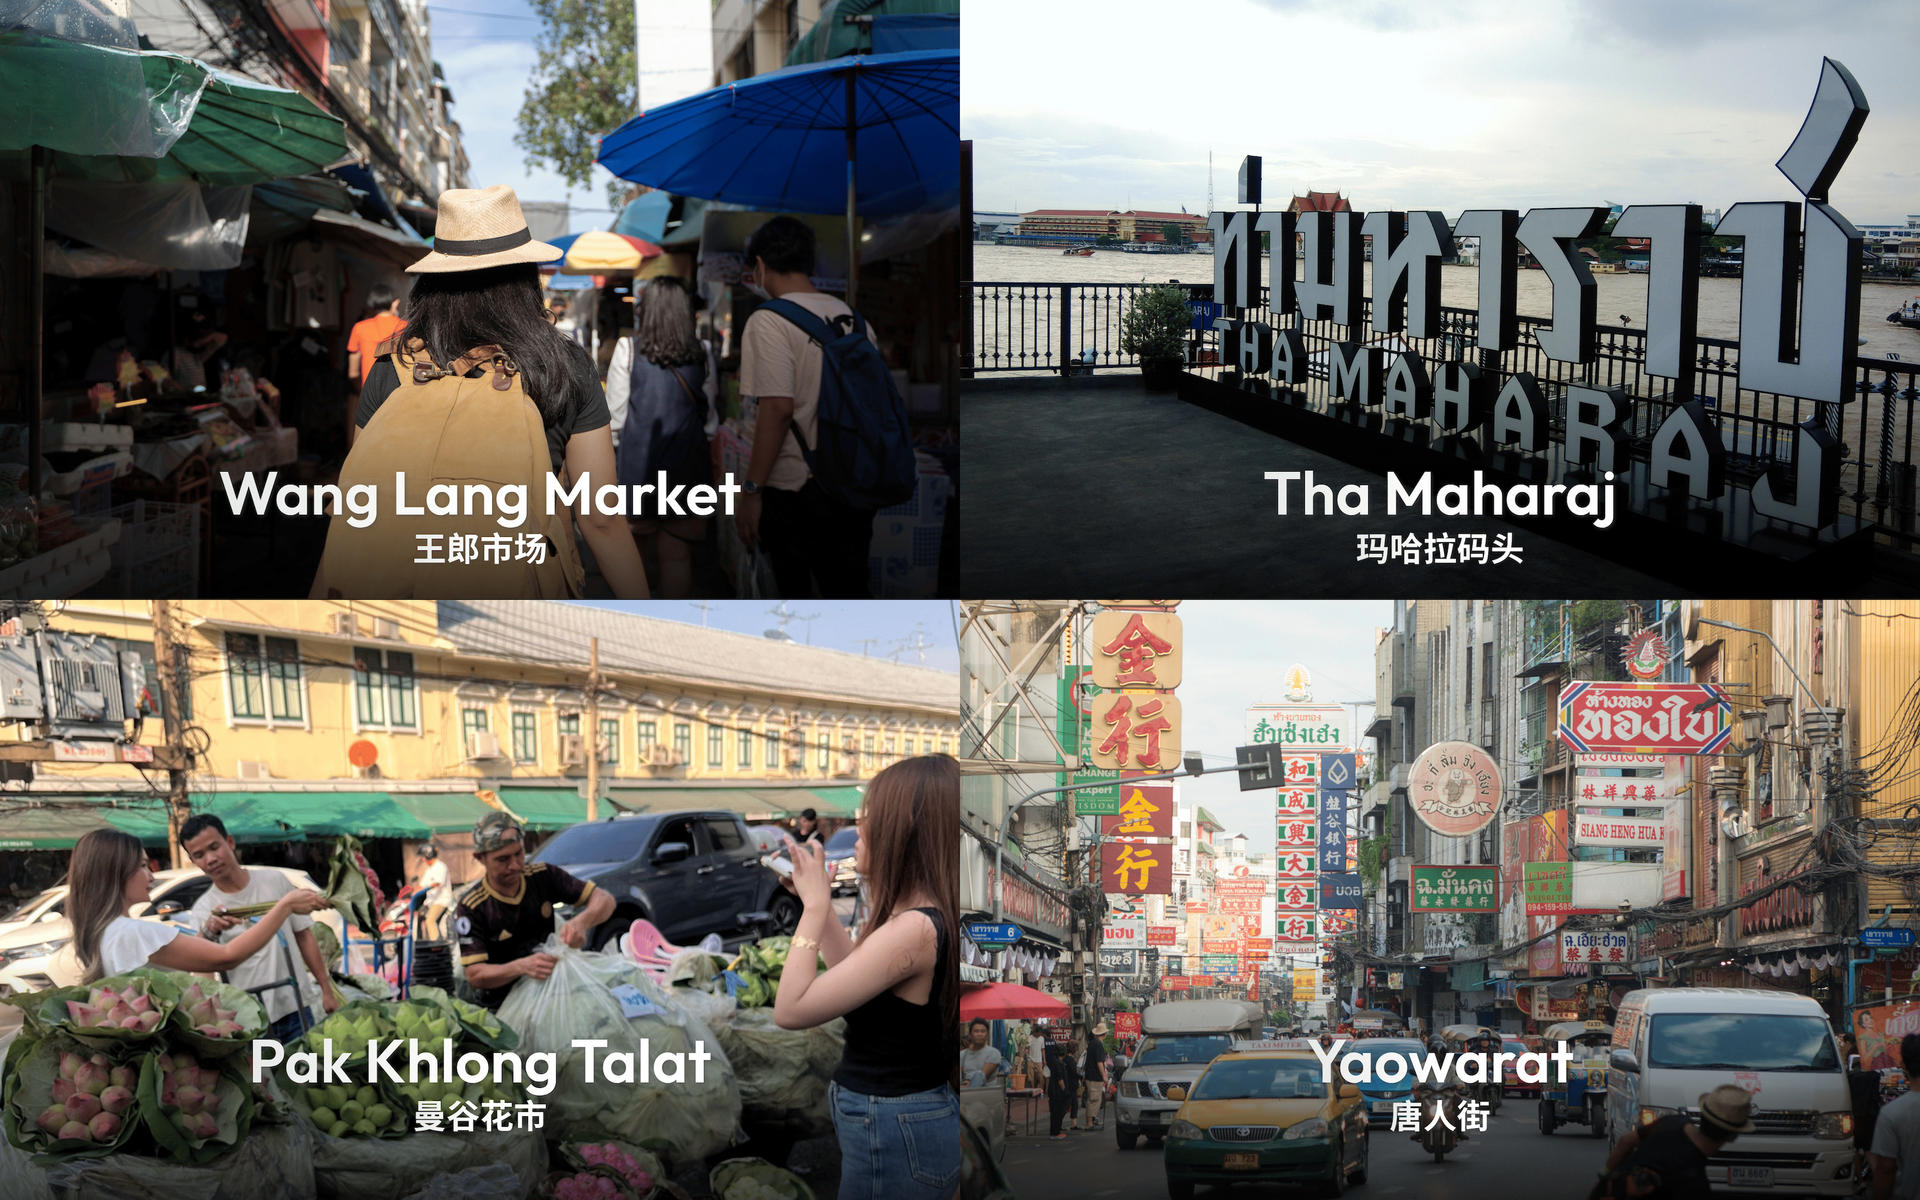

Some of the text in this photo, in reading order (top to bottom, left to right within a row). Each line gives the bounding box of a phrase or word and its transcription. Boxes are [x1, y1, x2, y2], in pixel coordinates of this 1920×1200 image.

[1214, 317, 1841, 530] THA MAHARAJ
[1098, 600, 1174, 768] 金行
[1586, 690, 1653, 709] ห้างทอง
[1577, 695, 1714, 742] ทองใบ
[1581, 783, 1664, 801] 林祥興藥
[1078, 802, 1115, 810] ISDOM
[1580, 823, 1609, 838] SIANG
[1610, 824, 1636, 839] HENG
[1638, 826, 1657, 840] HUA
[1286, 760, 1308, 939] 和成興大金行
[1335, 886, 1361, 896] UOB
[1007, 928, 1015, 937] 6
